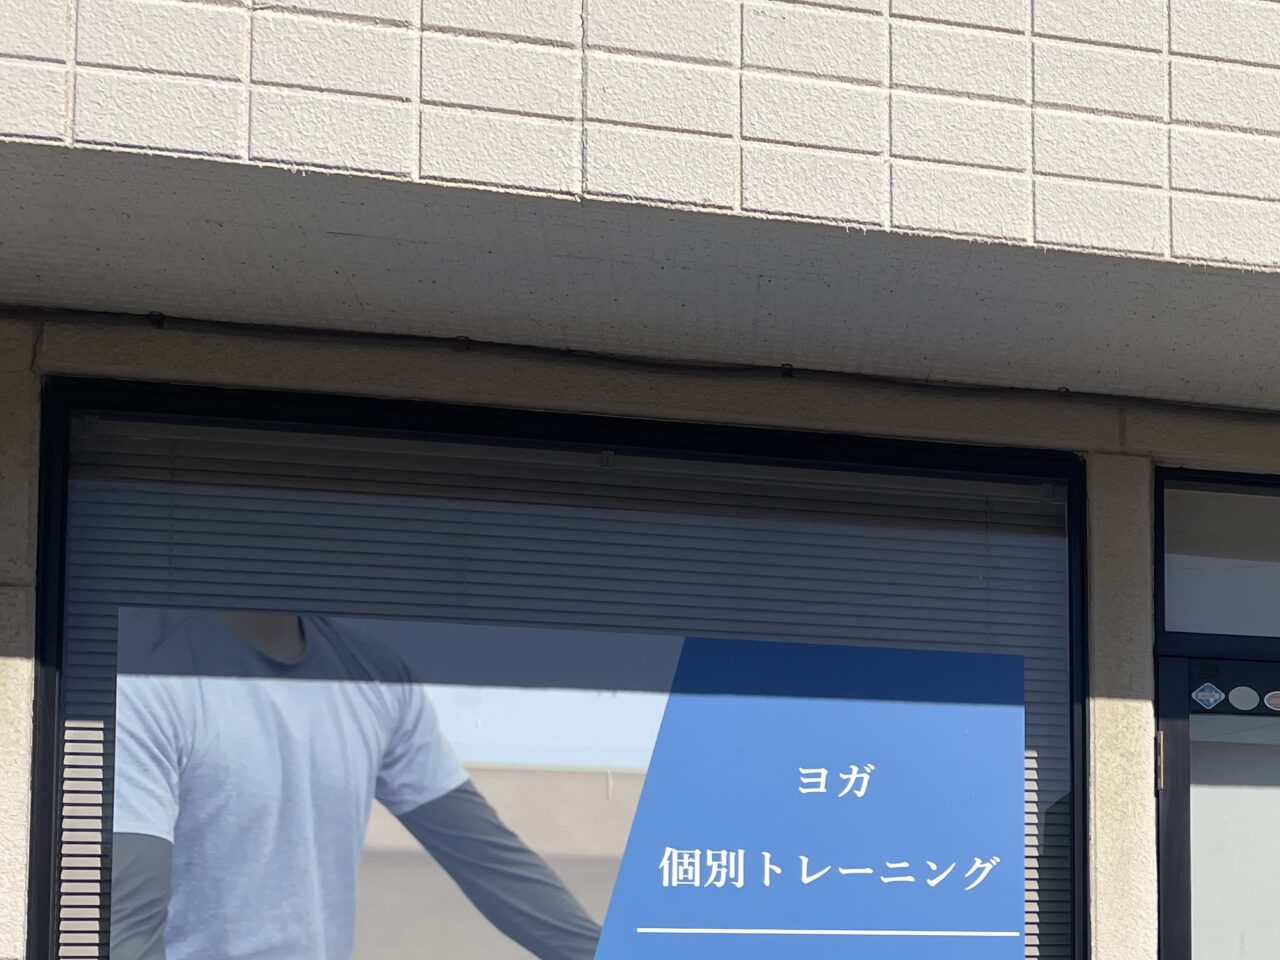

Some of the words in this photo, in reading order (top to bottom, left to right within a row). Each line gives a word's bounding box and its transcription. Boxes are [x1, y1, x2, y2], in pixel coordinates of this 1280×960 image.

[799, 763, 875, 798] ヨガ
[658, 846, 1000, 891] 個別トレーニング
